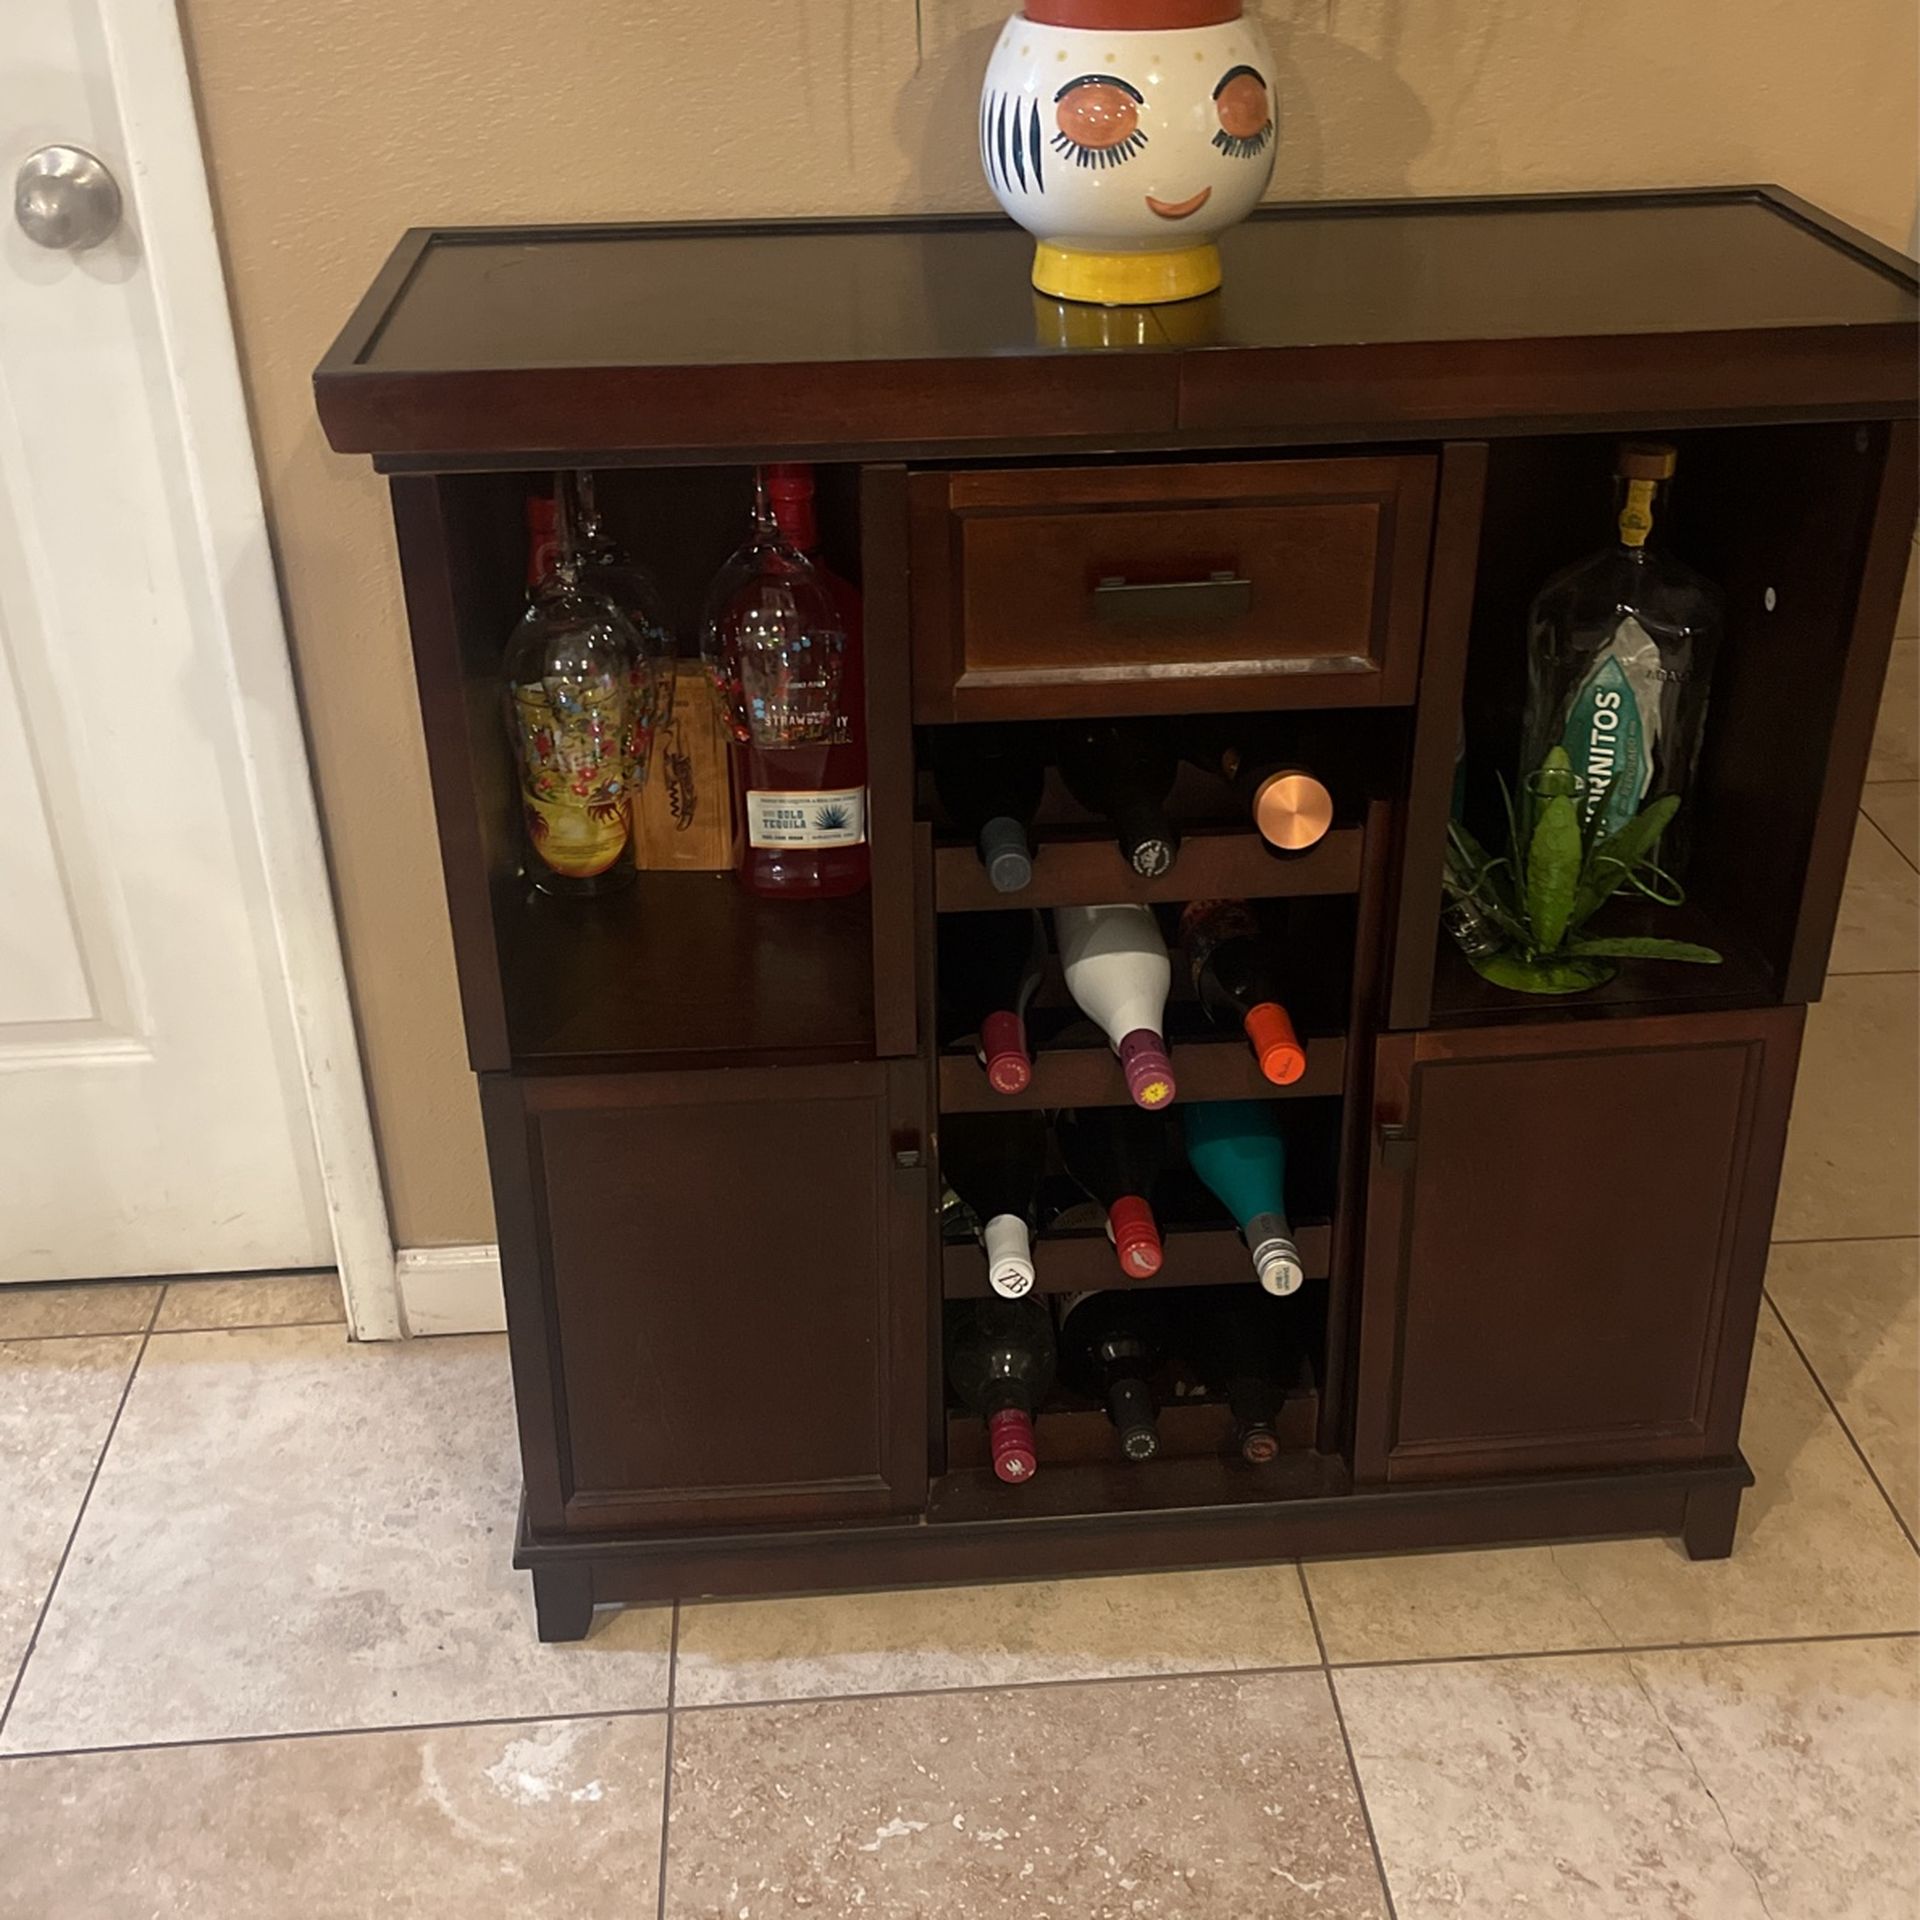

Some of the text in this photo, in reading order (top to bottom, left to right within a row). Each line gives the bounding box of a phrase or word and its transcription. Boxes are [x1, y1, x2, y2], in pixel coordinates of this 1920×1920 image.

[765, 716, 848, 727] STRAWBEY
[1585, 691, 1620, 836] ORNITOS
[763, 819, 806, 829] TEQUILA
